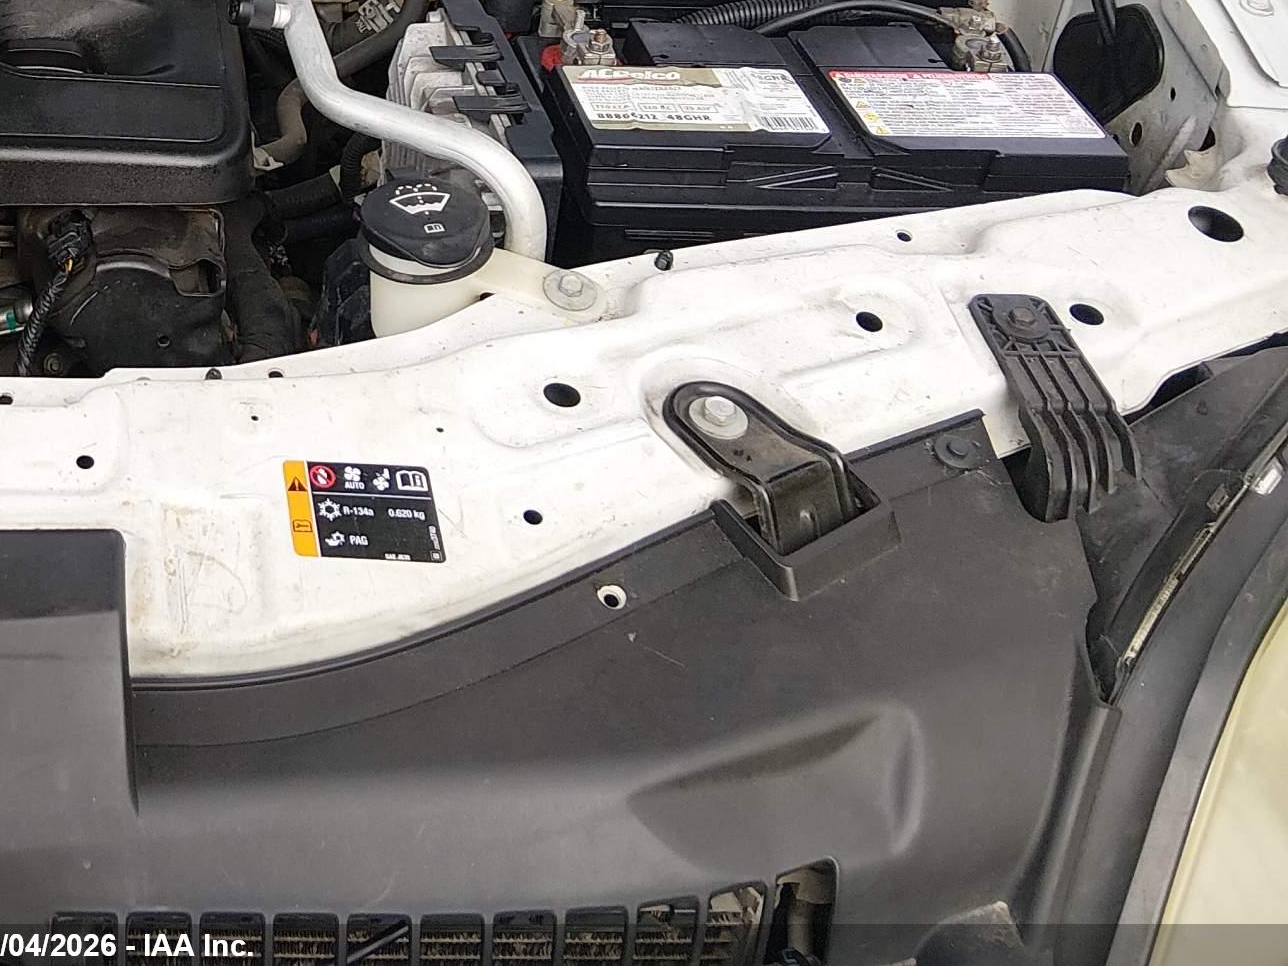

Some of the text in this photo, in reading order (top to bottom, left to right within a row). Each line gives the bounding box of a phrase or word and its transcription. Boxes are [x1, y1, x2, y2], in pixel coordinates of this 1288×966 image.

[578, 68, 681, 81] ACDelco
[667, 113, 712, 121] 48GHR
[343, 506, 425, 520] R-134a 0.620 kg
[349, 535, 369, 546] PAG
